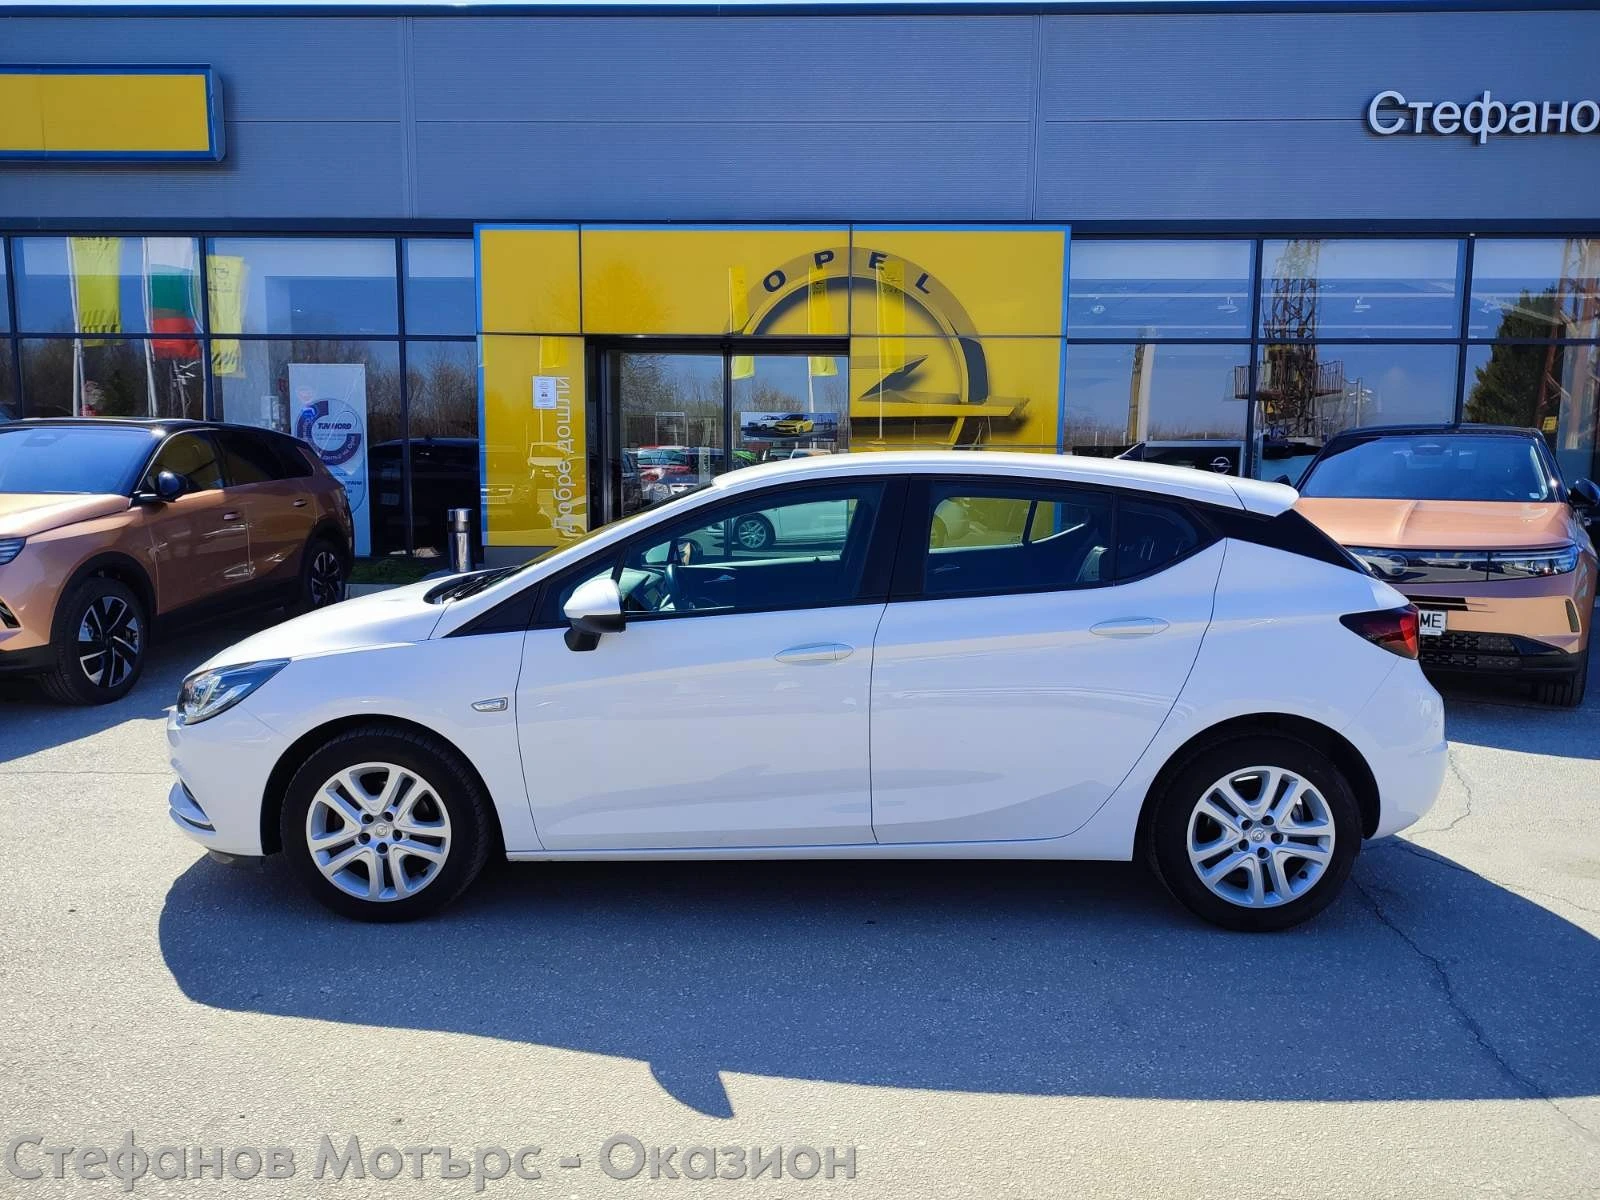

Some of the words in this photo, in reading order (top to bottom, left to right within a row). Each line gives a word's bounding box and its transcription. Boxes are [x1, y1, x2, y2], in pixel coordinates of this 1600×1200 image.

[1369, 91, 1600, 144] Стефано
[763, 250, 930, 294] OPEL
[556, 377, 574, 453] дошли
[553, 460, 576, 533] Добре
